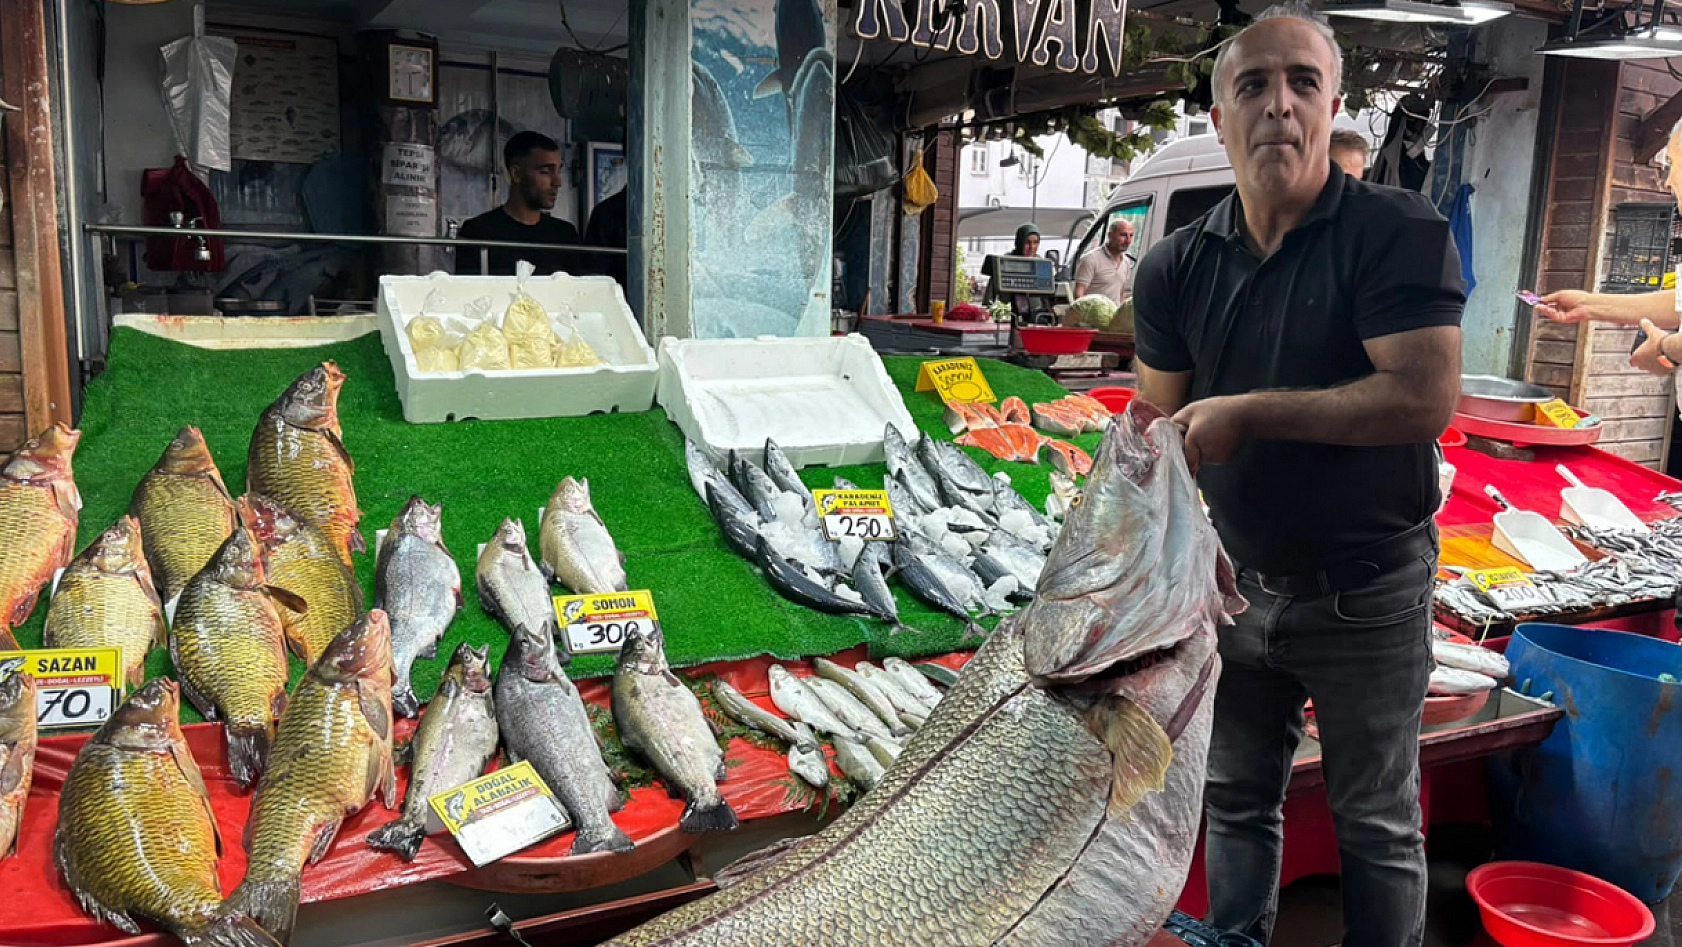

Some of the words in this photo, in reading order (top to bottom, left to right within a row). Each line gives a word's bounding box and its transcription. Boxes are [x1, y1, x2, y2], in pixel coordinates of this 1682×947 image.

[839, 515, 881, 538] 250
[1498, 586, 1535, 600] 200
[592, 597, 636, 610] SOMON
[37, 656, 97, 673] SAZAN
[37, 688, 91, 722] 70
[476, 773, 517, 793] DOĞAL
